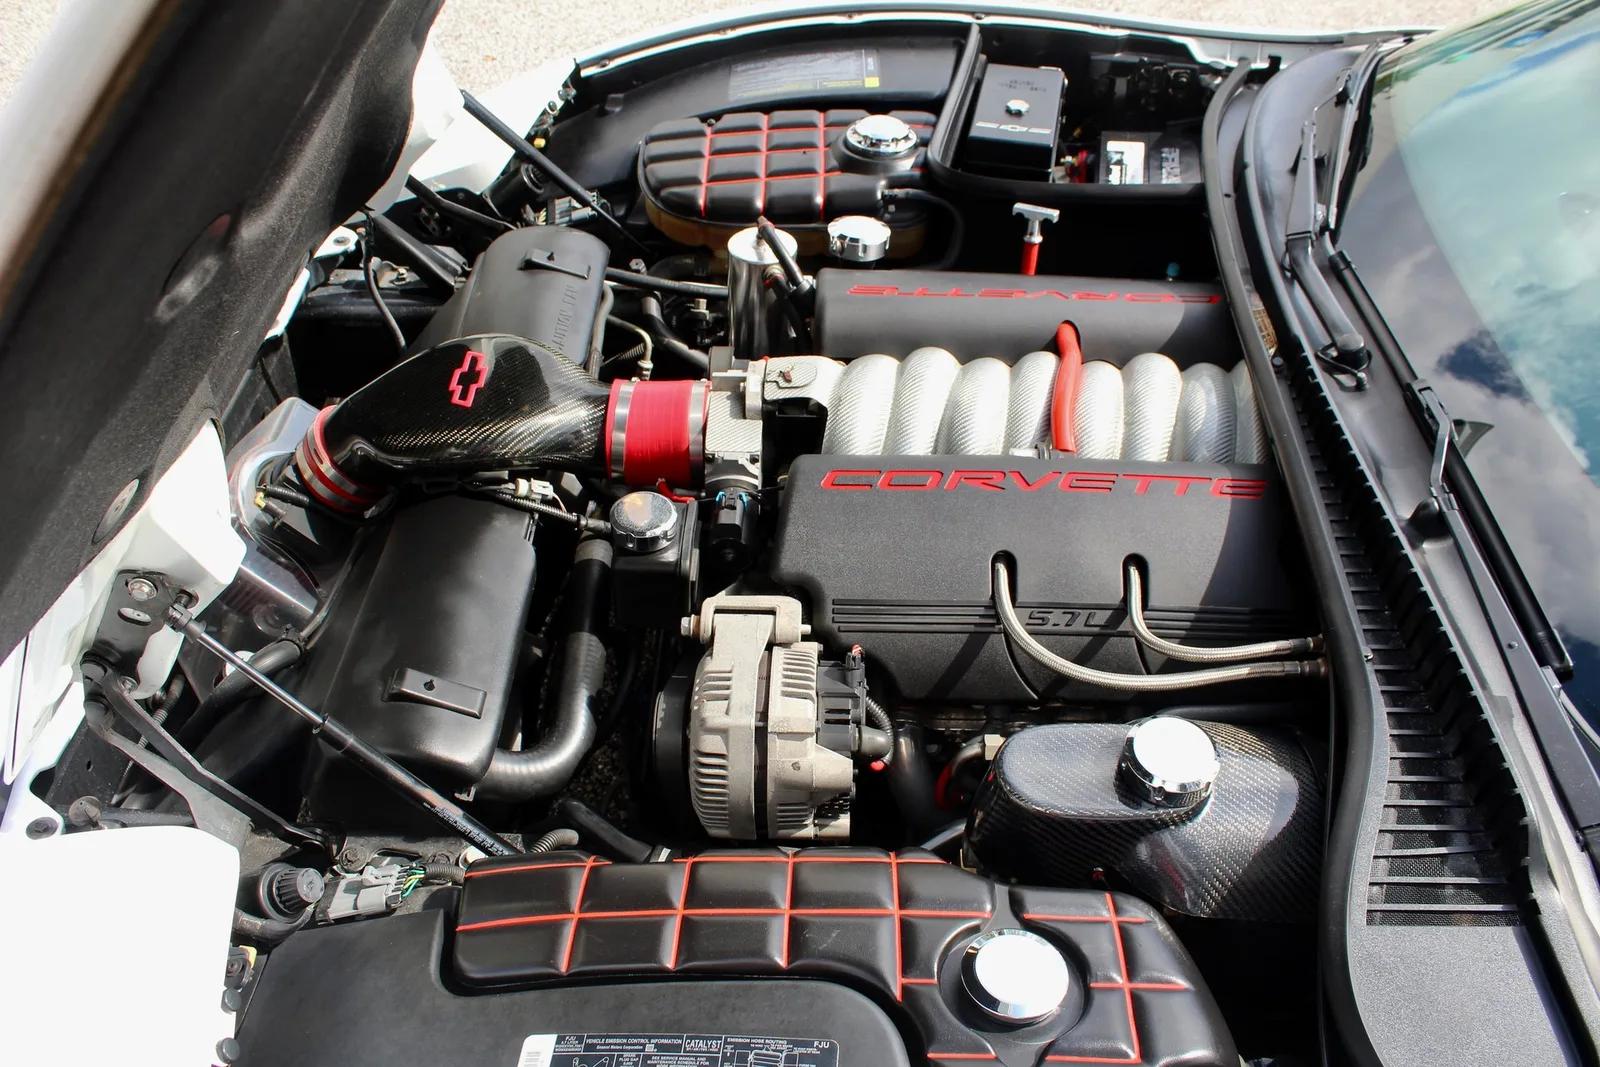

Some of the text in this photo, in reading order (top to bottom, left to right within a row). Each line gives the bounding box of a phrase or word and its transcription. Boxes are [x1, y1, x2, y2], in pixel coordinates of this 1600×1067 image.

[847, 284, 1223, 304] CORVETTE
[819, 469, 1269, 499] CORVETTE
[1025, 609, 1109, 628] 5.7L
[685, 1039, 722, 1049] CATALYST
